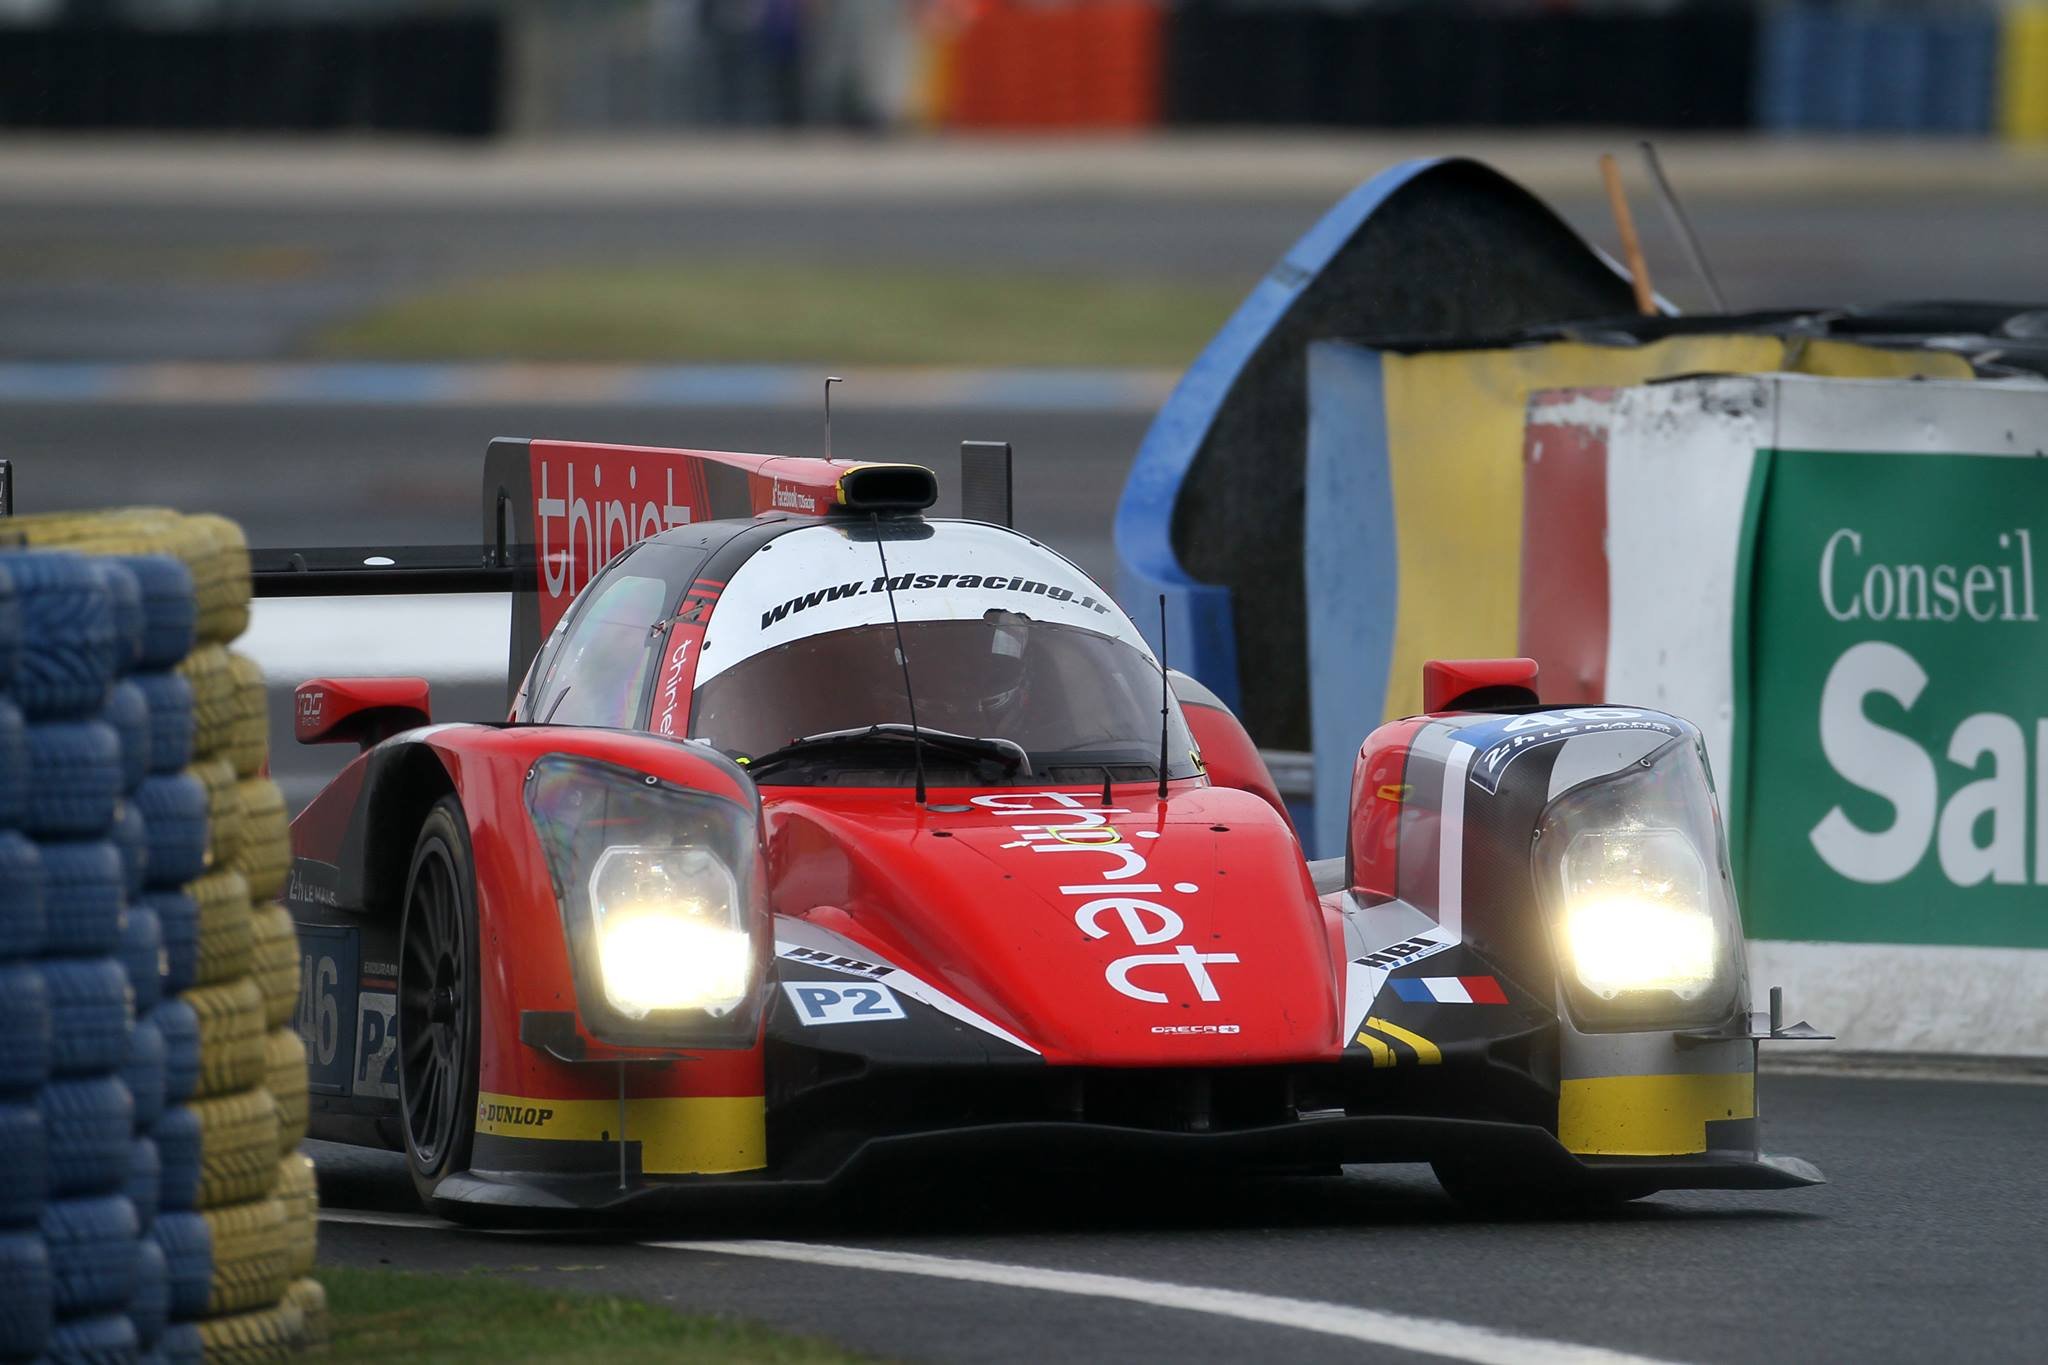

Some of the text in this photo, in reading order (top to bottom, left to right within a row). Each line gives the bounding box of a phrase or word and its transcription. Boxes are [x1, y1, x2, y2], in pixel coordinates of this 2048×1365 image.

[1819, 528, 2039, 622] Conseil
[761, 572, 1111, 631] www.tdsracing.fr
[660, 639, 693, 736] thirie
[1503, 708, 1643, 732] 46
[1542, 726, 1579, 738] LE
[1808, 640, 2048, 887] Sa
[970, 791, 1240, 1004] thiriet
[1352, 936, 1440, 968] HBI
[796, 988, 893, 1018] P2
[1151, 1025, 1217, 1034] ORECA
[487, 1103, 553, 1127] DUNLOP
